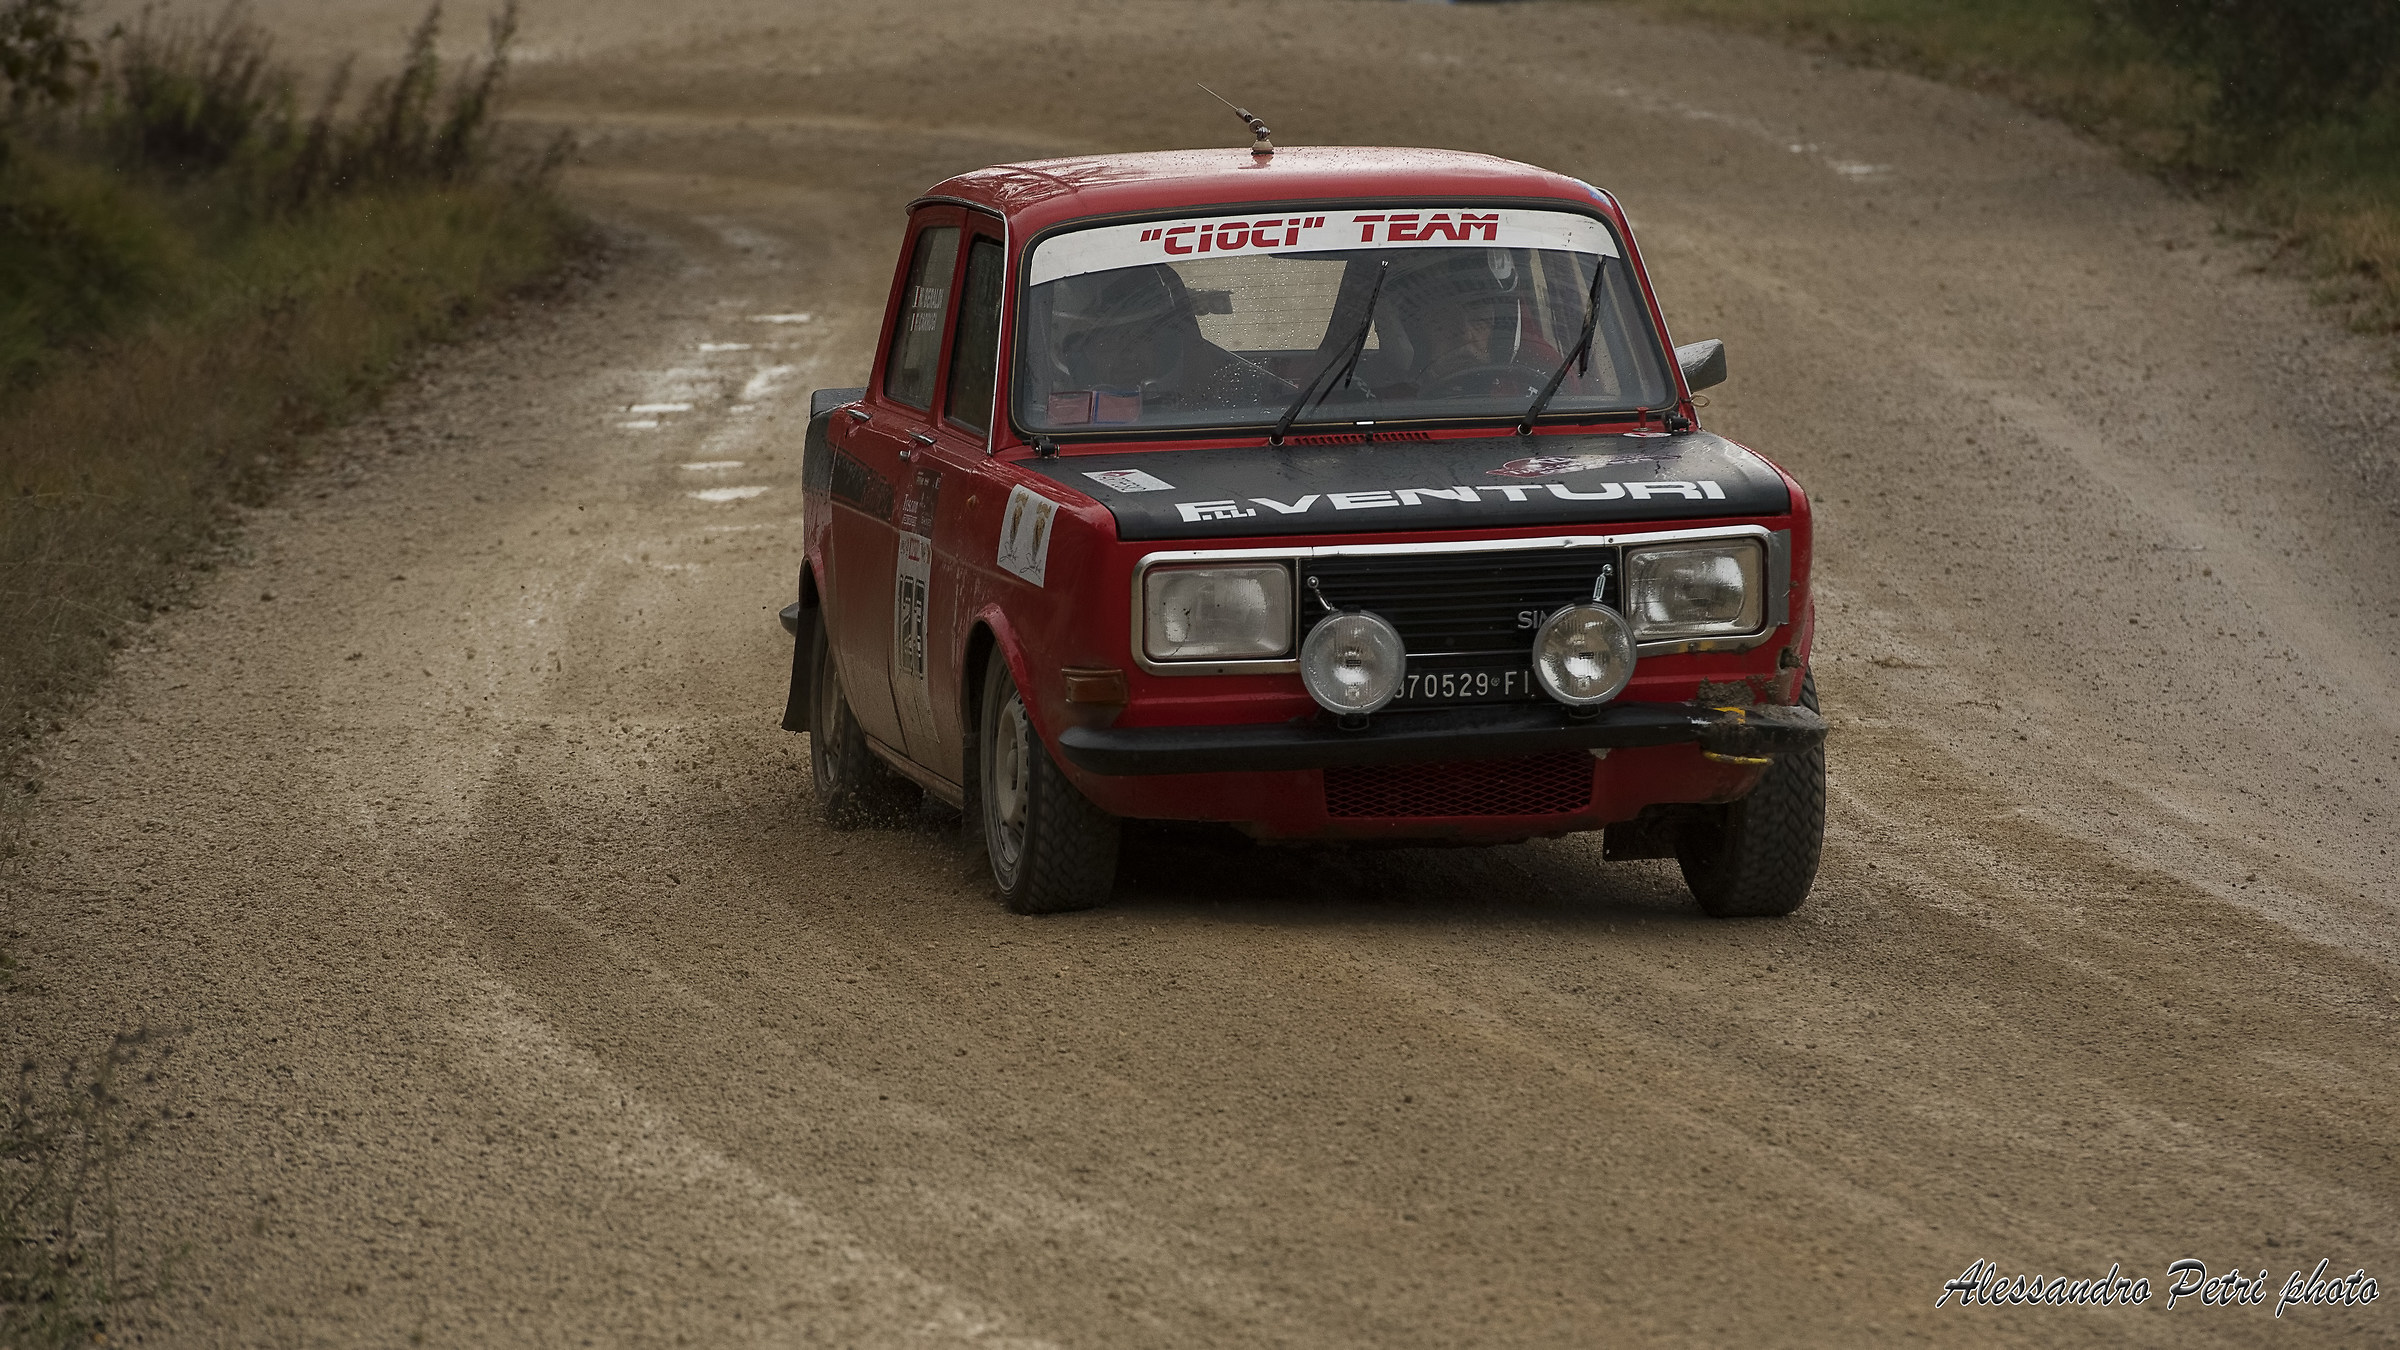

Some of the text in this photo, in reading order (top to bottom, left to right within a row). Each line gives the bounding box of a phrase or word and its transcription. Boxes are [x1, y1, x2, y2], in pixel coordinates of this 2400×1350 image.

[1353, 213, 1499, 243] TEAM
[1248, 481, 1726, 516] VENTURI
[1504, 670, 1529, 695] FI
